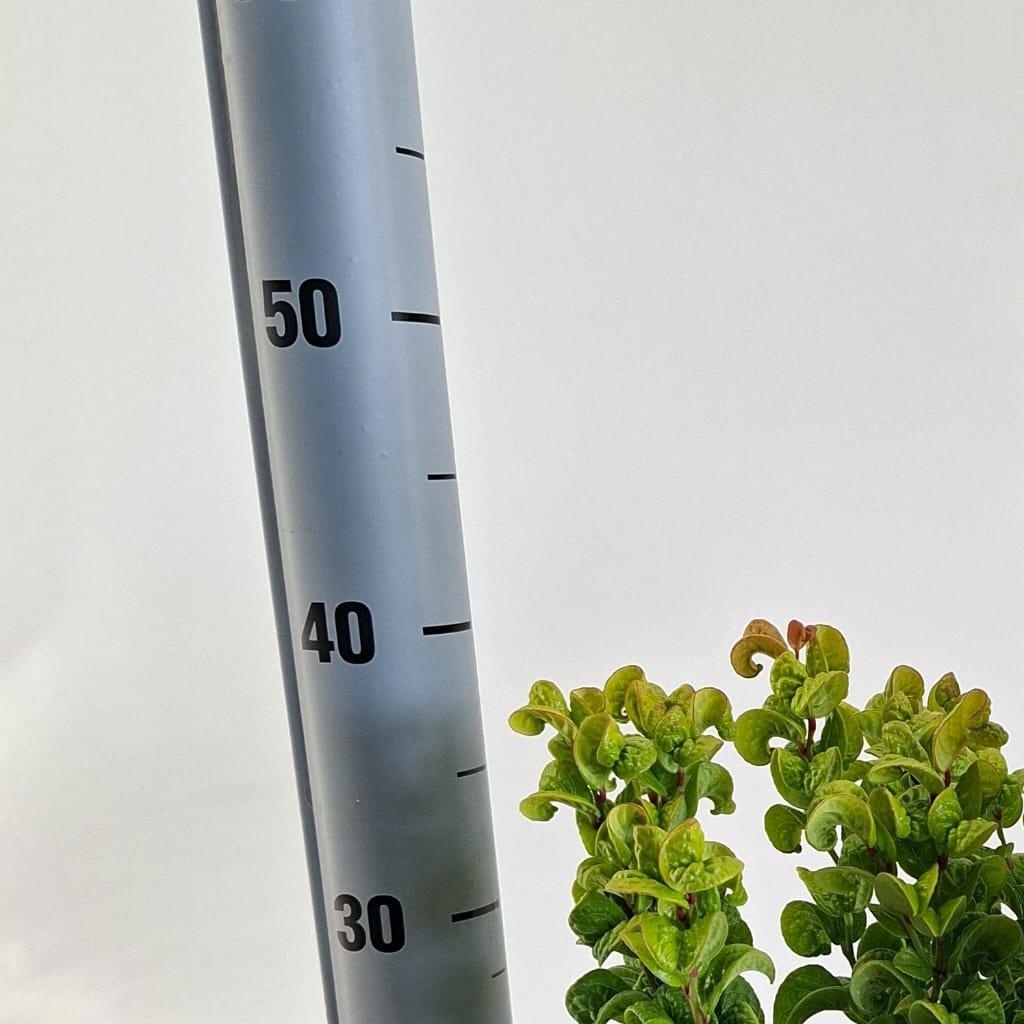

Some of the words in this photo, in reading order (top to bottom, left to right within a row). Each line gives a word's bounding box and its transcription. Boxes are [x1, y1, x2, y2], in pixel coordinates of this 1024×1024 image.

[264, 279, 341, 347] 50
[302, 602, 375, 664] 40
[334, 894, 405, 953] 30
